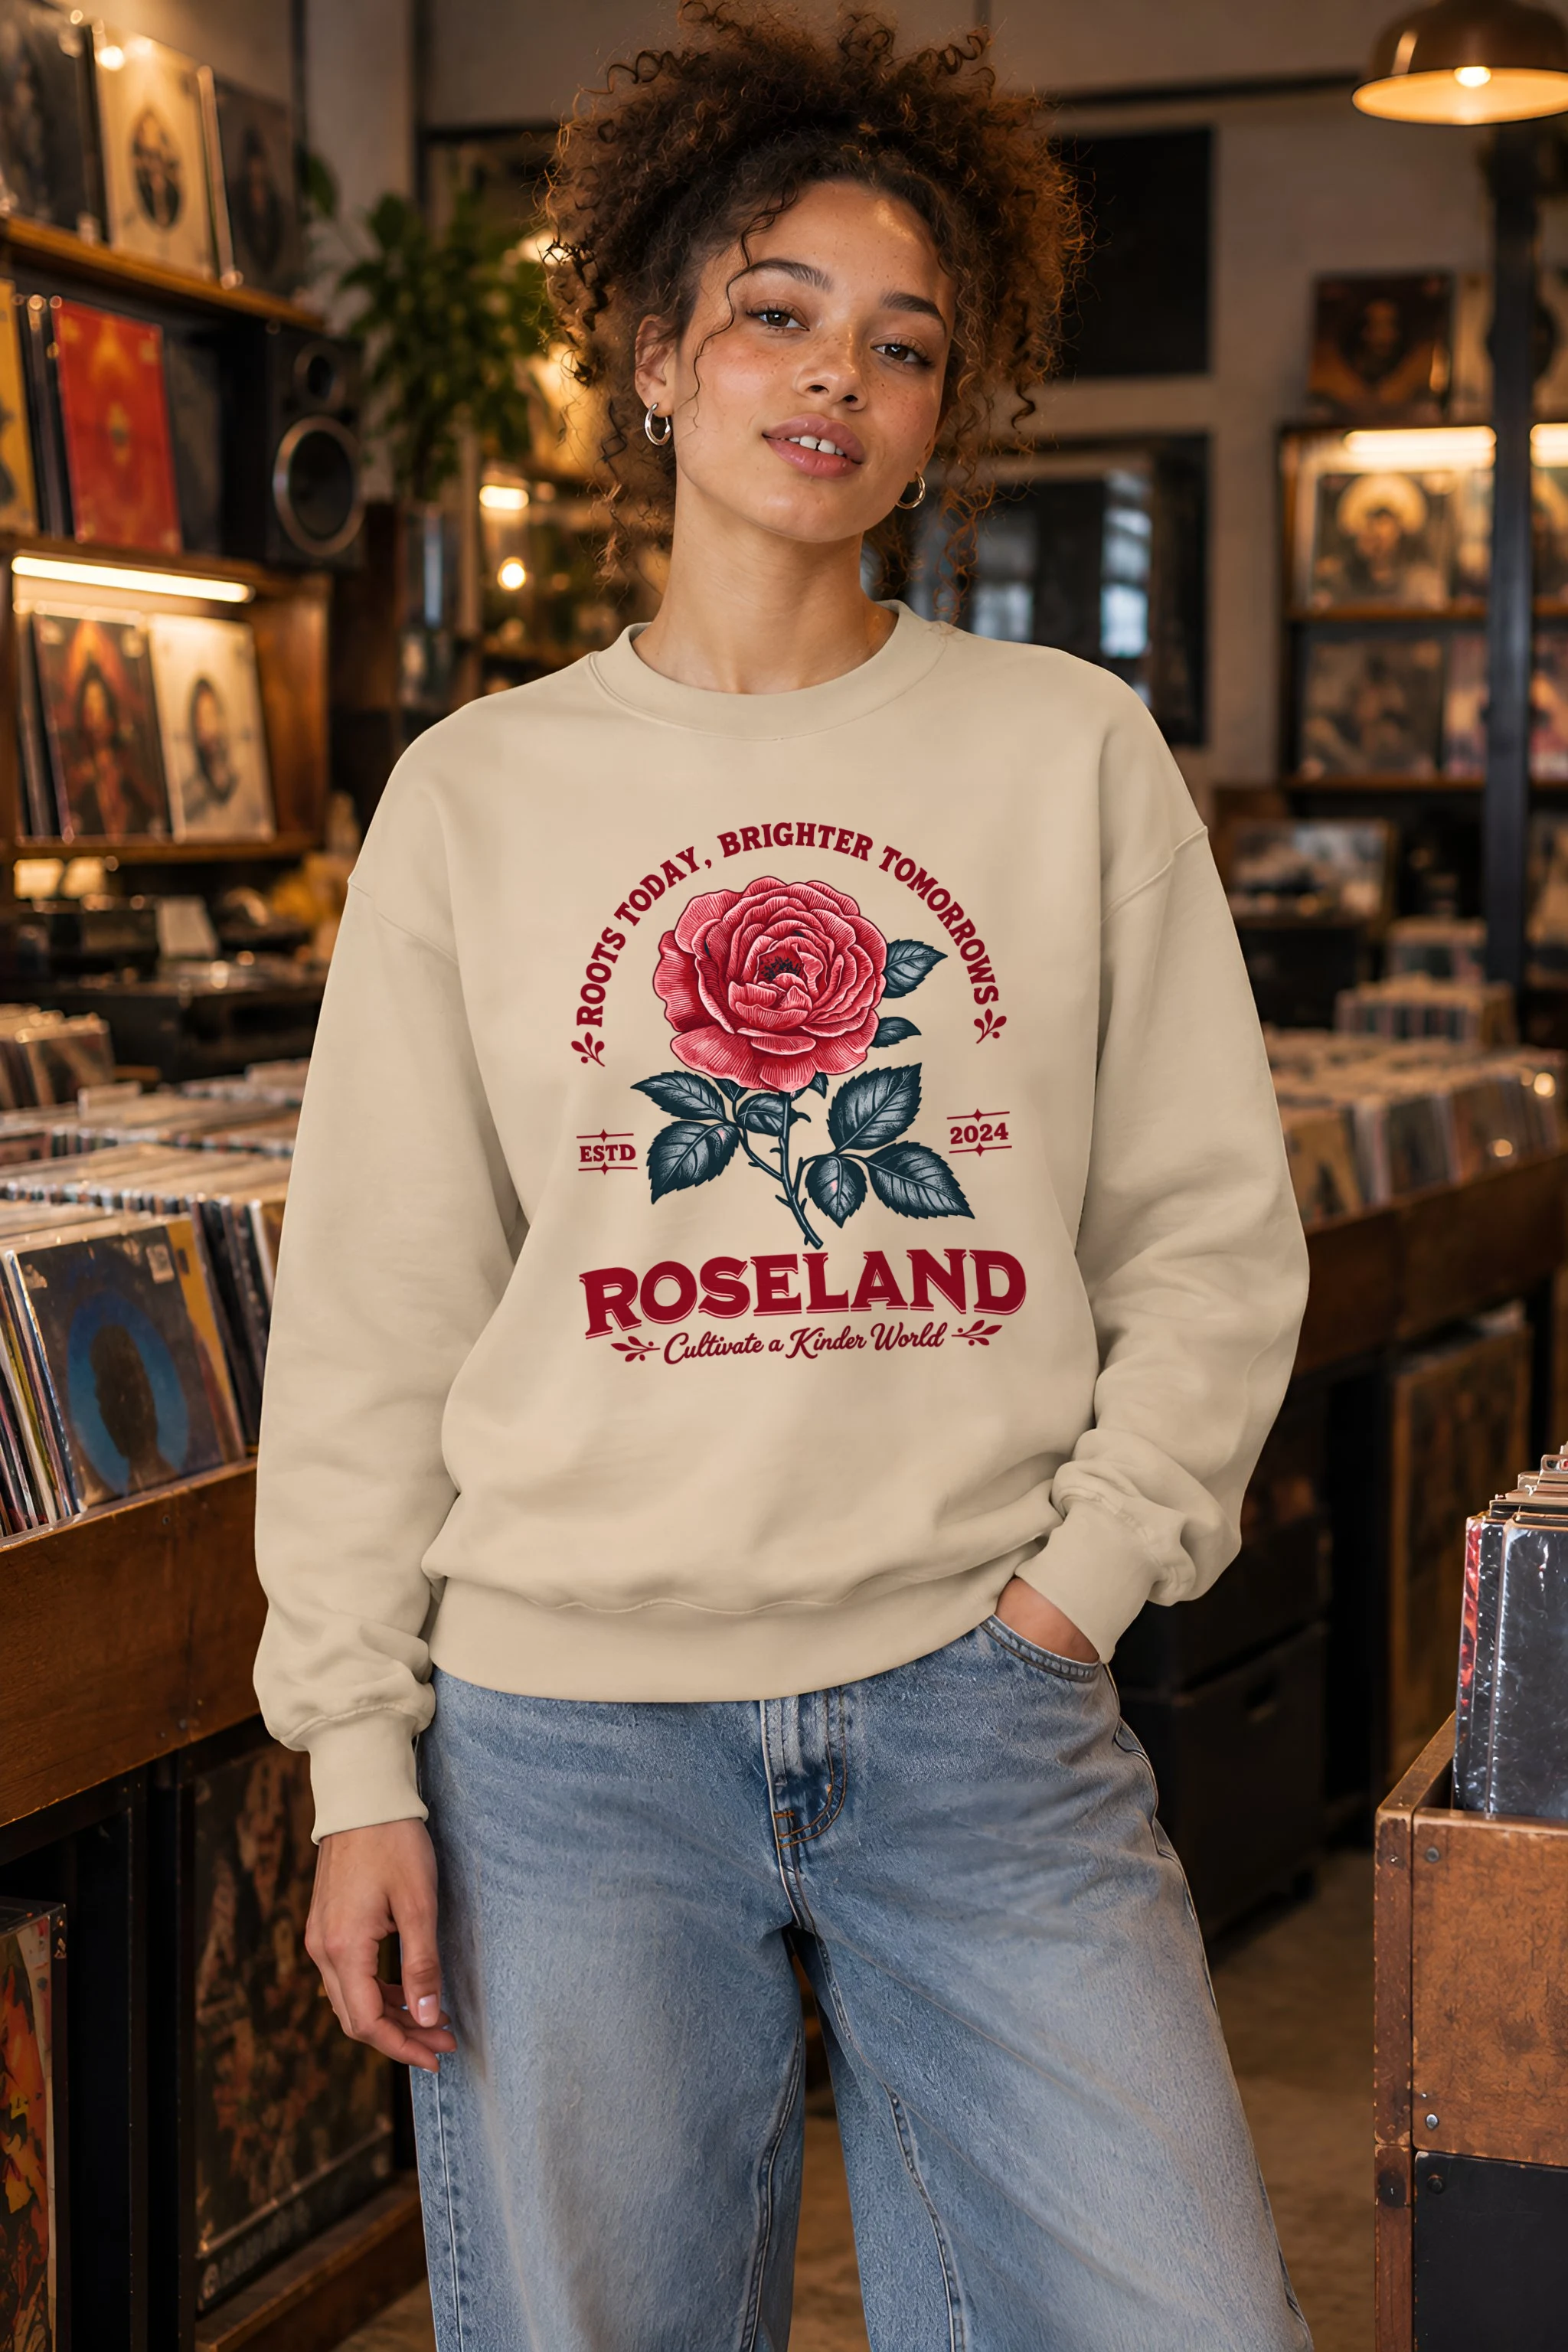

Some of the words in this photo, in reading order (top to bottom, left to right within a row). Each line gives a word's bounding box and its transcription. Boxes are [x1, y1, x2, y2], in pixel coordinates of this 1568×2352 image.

[577, 926, 626, 1027] ROOTS
[614, 846, 712, 926] TODAY,
[717, 822, 874, 861] BRIGHTER
[878, 845, 999, 1005] TOMORROWS
[580, 1144, 636, 1163] ESTD
[949, 1122, 1010, 1145] 2024
[579, 1249, 1027, 1340] ROSELAND
[663, 1331, 765, 1365] Cultivate
[768, 1338, 785, 1353] a
[785, 1325, 867, 1360] Kinder
[870, 1321, 948, 1351] World
